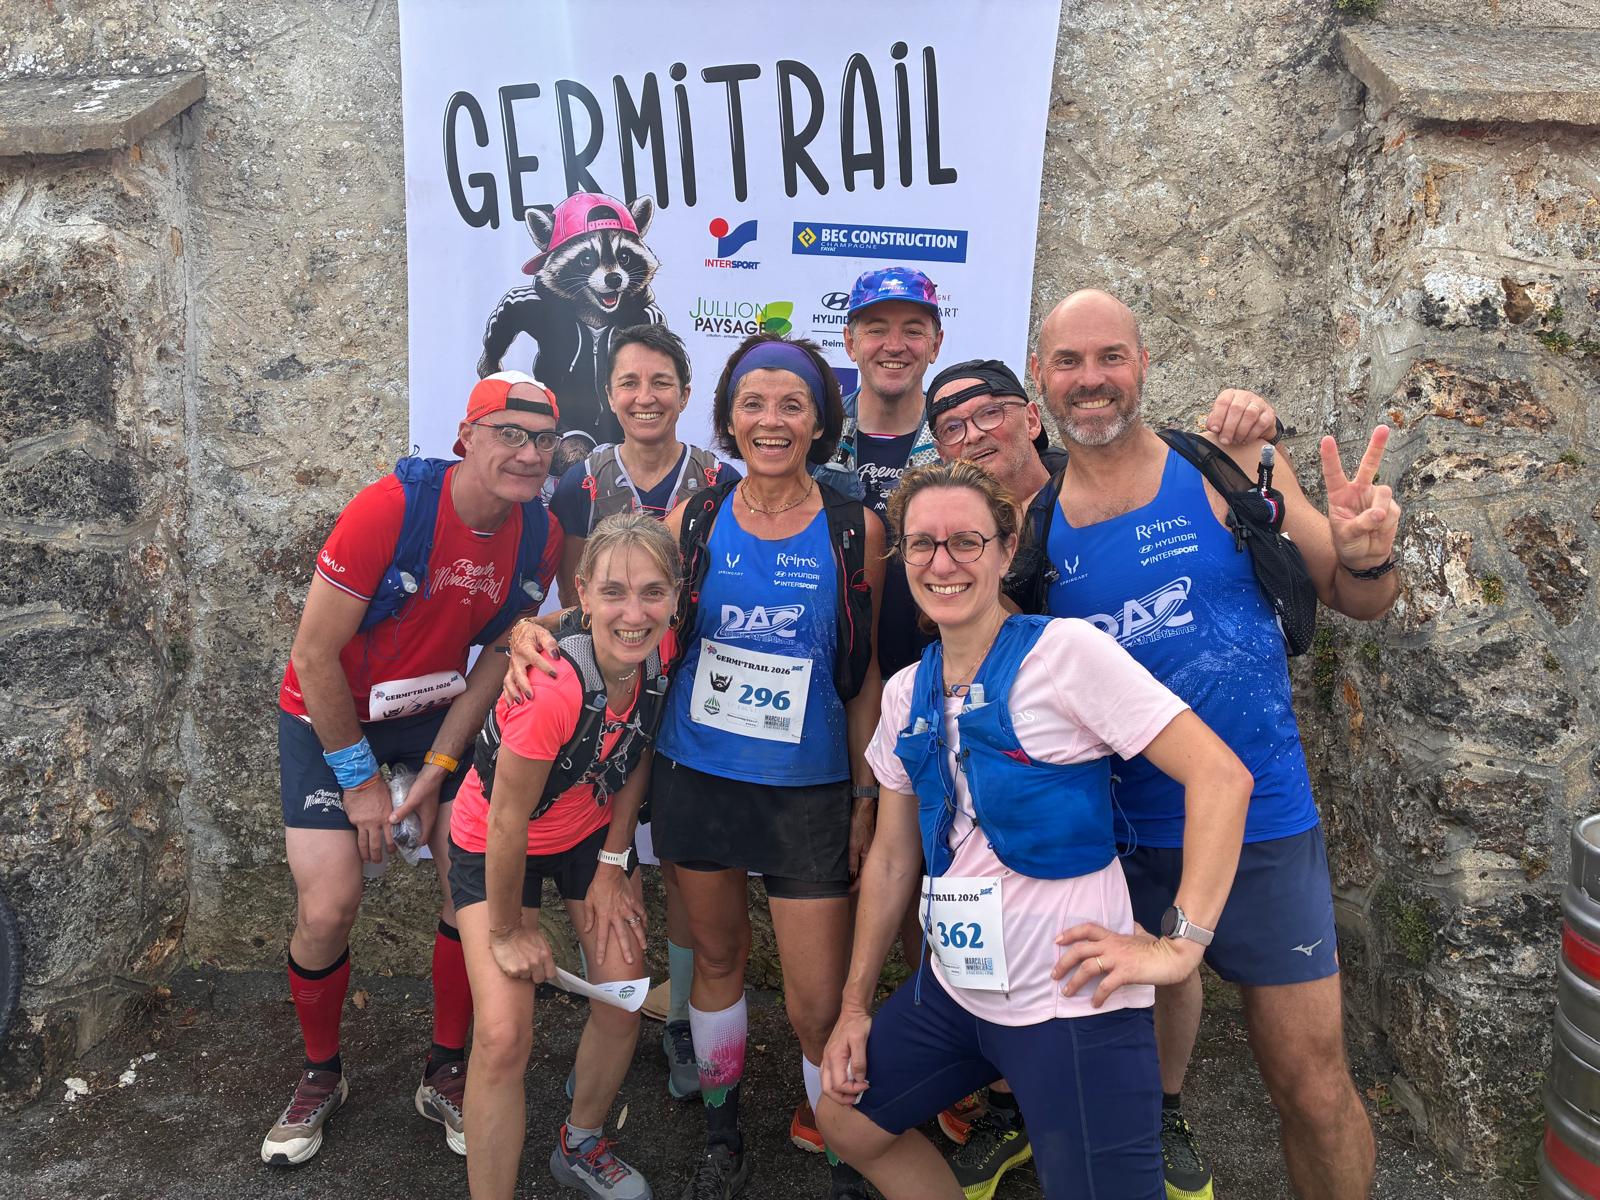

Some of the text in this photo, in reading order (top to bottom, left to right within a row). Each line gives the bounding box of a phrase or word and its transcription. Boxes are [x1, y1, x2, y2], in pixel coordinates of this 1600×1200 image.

[820, 241, 877, 250] CHAMPAGNE
[821, 228, 958, 249] BEC CONSTRUCTION
[704, 258, 760, 270] INTERSPORT
[689, 297, 768, 319] JULLION
[812, 314, 848, 325] HYUND
[822, 339, 846, 348] Reim
[857, 463, 903, 481] Frenc
[1155, 532, 1197, 549] HYUNDAI
[1150, 544, 1199, 564] INTERSPORT
[788, 571, 820, 581] HYUNDAI
[780, 580, 818, 590] INTERSPORT
[721, 604, 799, 638] DAC
[771, 666, 791, 675] 2026
[738, 684, 791, 711] 296
[958, 893, 979, 902] 2026
[937, 921, 984, 949] 362
